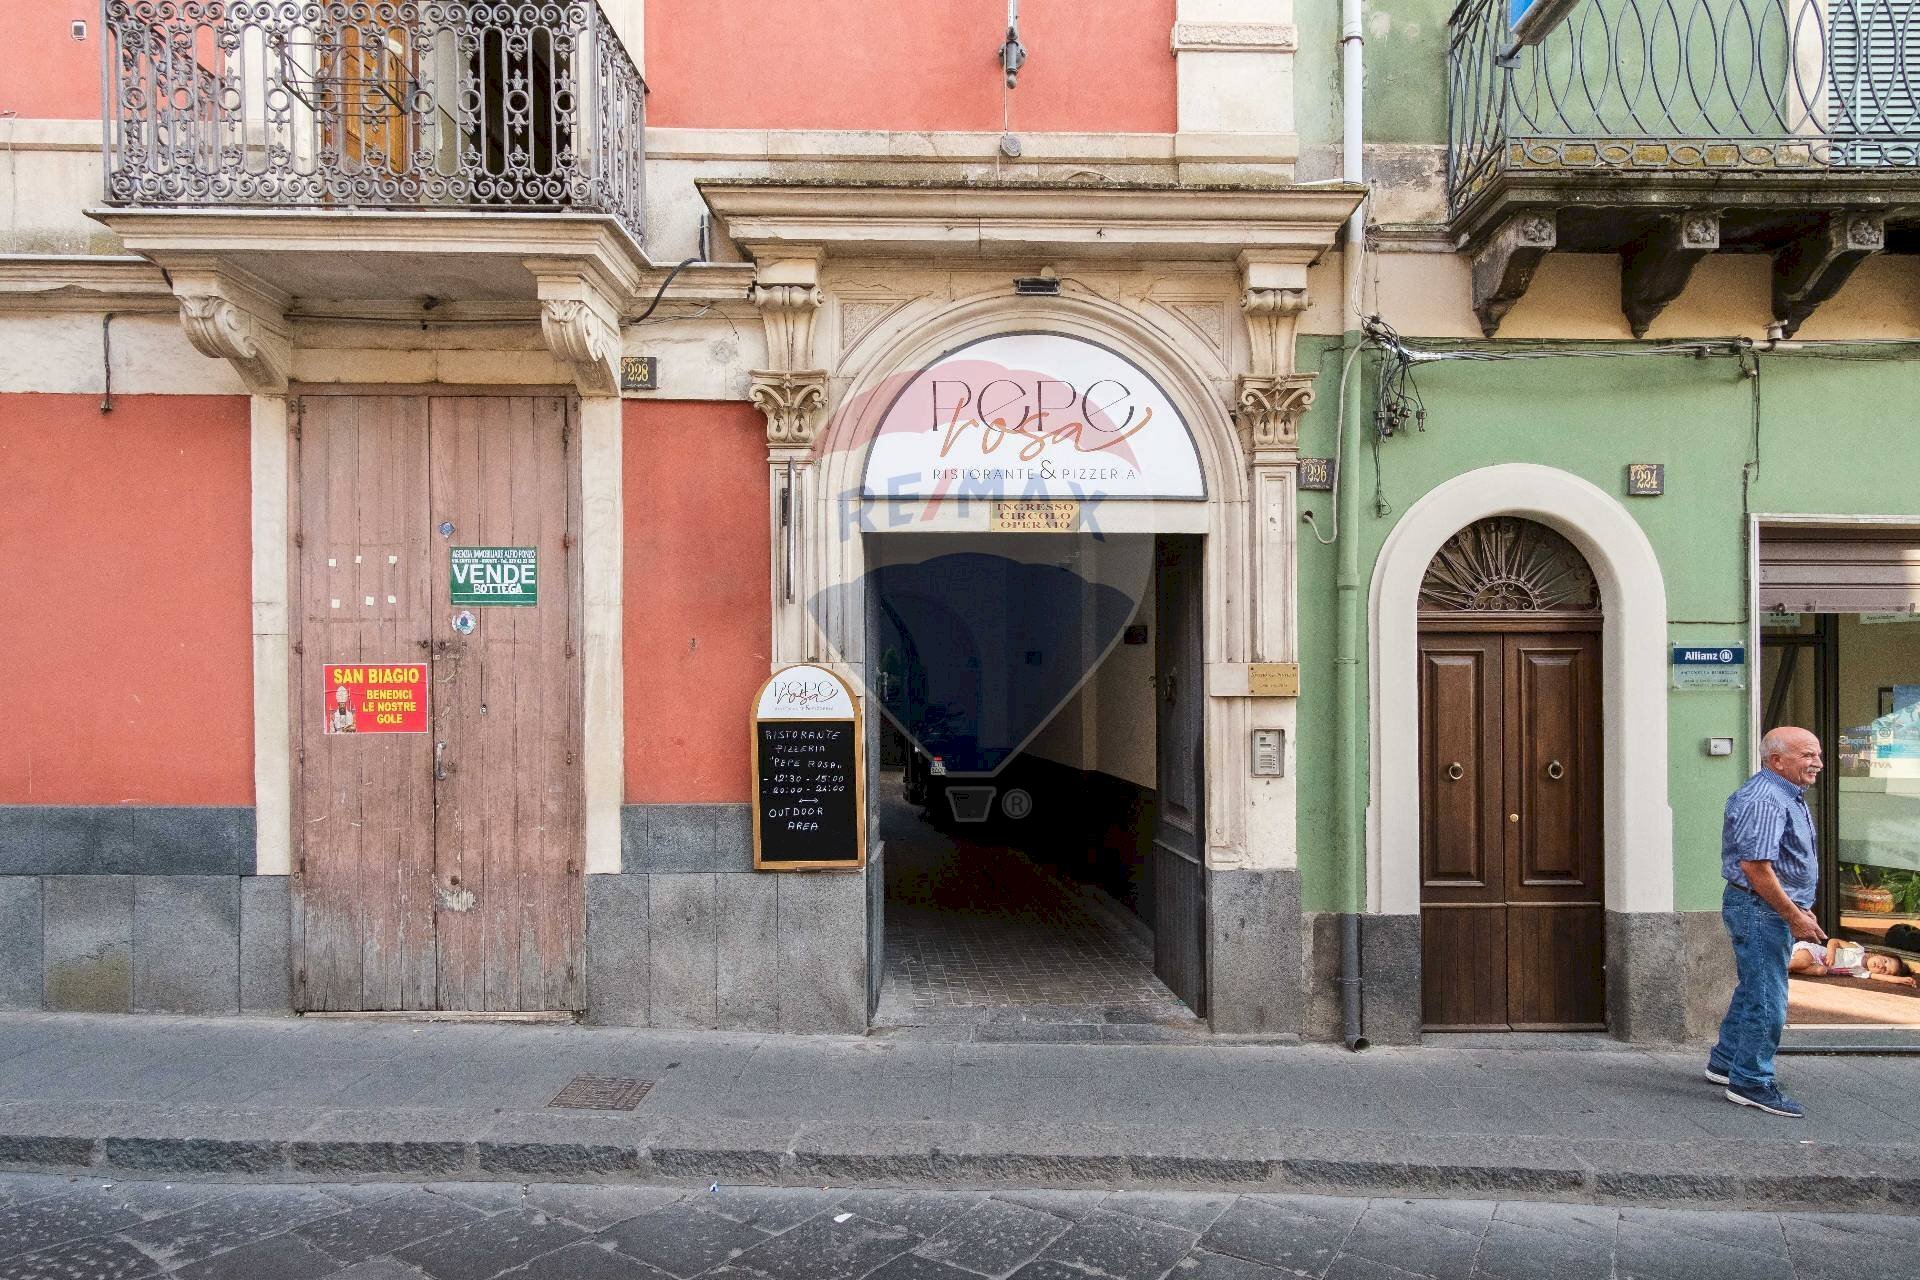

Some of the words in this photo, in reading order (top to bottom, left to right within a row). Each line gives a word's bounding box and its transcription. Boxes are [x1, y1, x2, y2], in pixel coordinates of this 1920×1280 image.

[628, 363, 648, 381] 228
[933, 468, 1034, 480] RISTORANTE
[1040, 459, 1057, 480] &
[1062, 468, 1136, 480] PIZZERA
[1307, 464, 1327, 482] 226
[1637, 470, 1658, 488] 224
[997, 503, 1074, 511] INGRESSO
[1000, 512, 1071, 520] CIRCOLO
[1000, 521, 1071, 529] OPERAIO
[453, 564, 536, 584] VENDE
[474, 584, 523, 593] BOTTEGA
[1684, 651, 1718, 660] Allianz
[333, 668, 364, 684] SAN
[368, 668, 419, 684] BIAGIO
[366, 690, 412, 699] BENEDICI
[363, 702, 375, 712] LE
[378, 702, 416, 712] NOSTRE
[377, 714, 403, 724] GOLE
[765, 729, 841, 740] RISTORANTE
[776, 745, 825, 754] PIZZERIA
[788, 822, 818, 831] AREA
